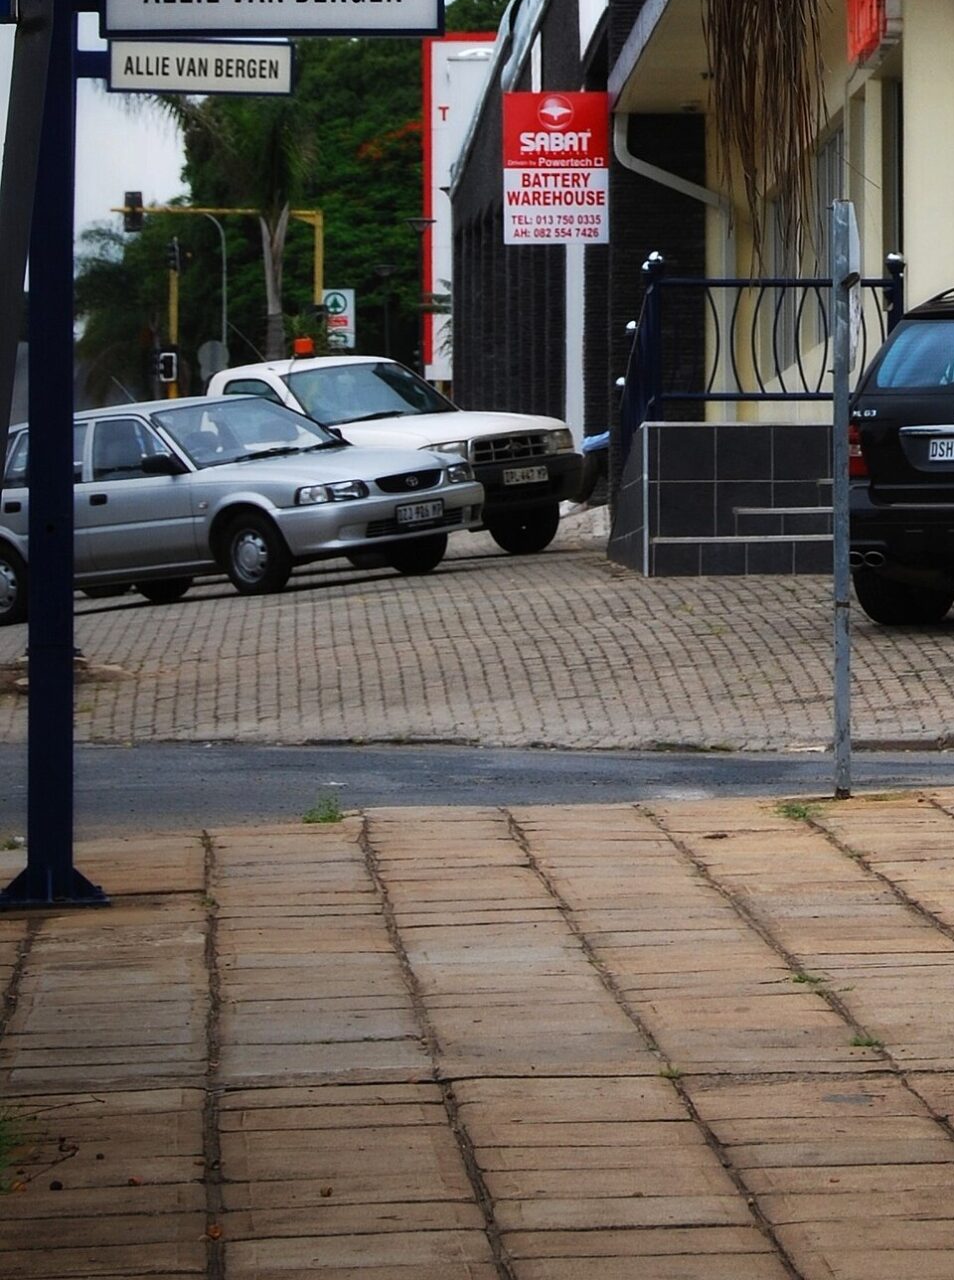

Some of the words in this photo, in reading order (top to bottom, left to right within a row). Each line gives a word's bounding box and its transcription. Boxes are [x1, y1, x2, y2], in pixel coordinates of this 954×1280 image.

[124, 55, 170, 77] ALLIE
[176, 57, 209, 78] VAN
[214, 57, 279, 79] BERGEN
[519, 131, 592, 152] SABAT
[538, 157, 592, 167] Powertech
[521, 172, 591, 188] BATTERY
[507, 191, 605, 206] WAREHOUSE
[511, 215, 533, 225] TEL:
[536, 215, 553, 225] 013
[556, 215, 574, 225] 750
[577, 214, 602, 225] 0335
[513, 228, 531, 238] AH:
[533, 228, 552, 238] 082
[554, 228, 572, 238] 554
[575, 228, 599, 238] 7426
[930, 441, 953, 458] DSH
